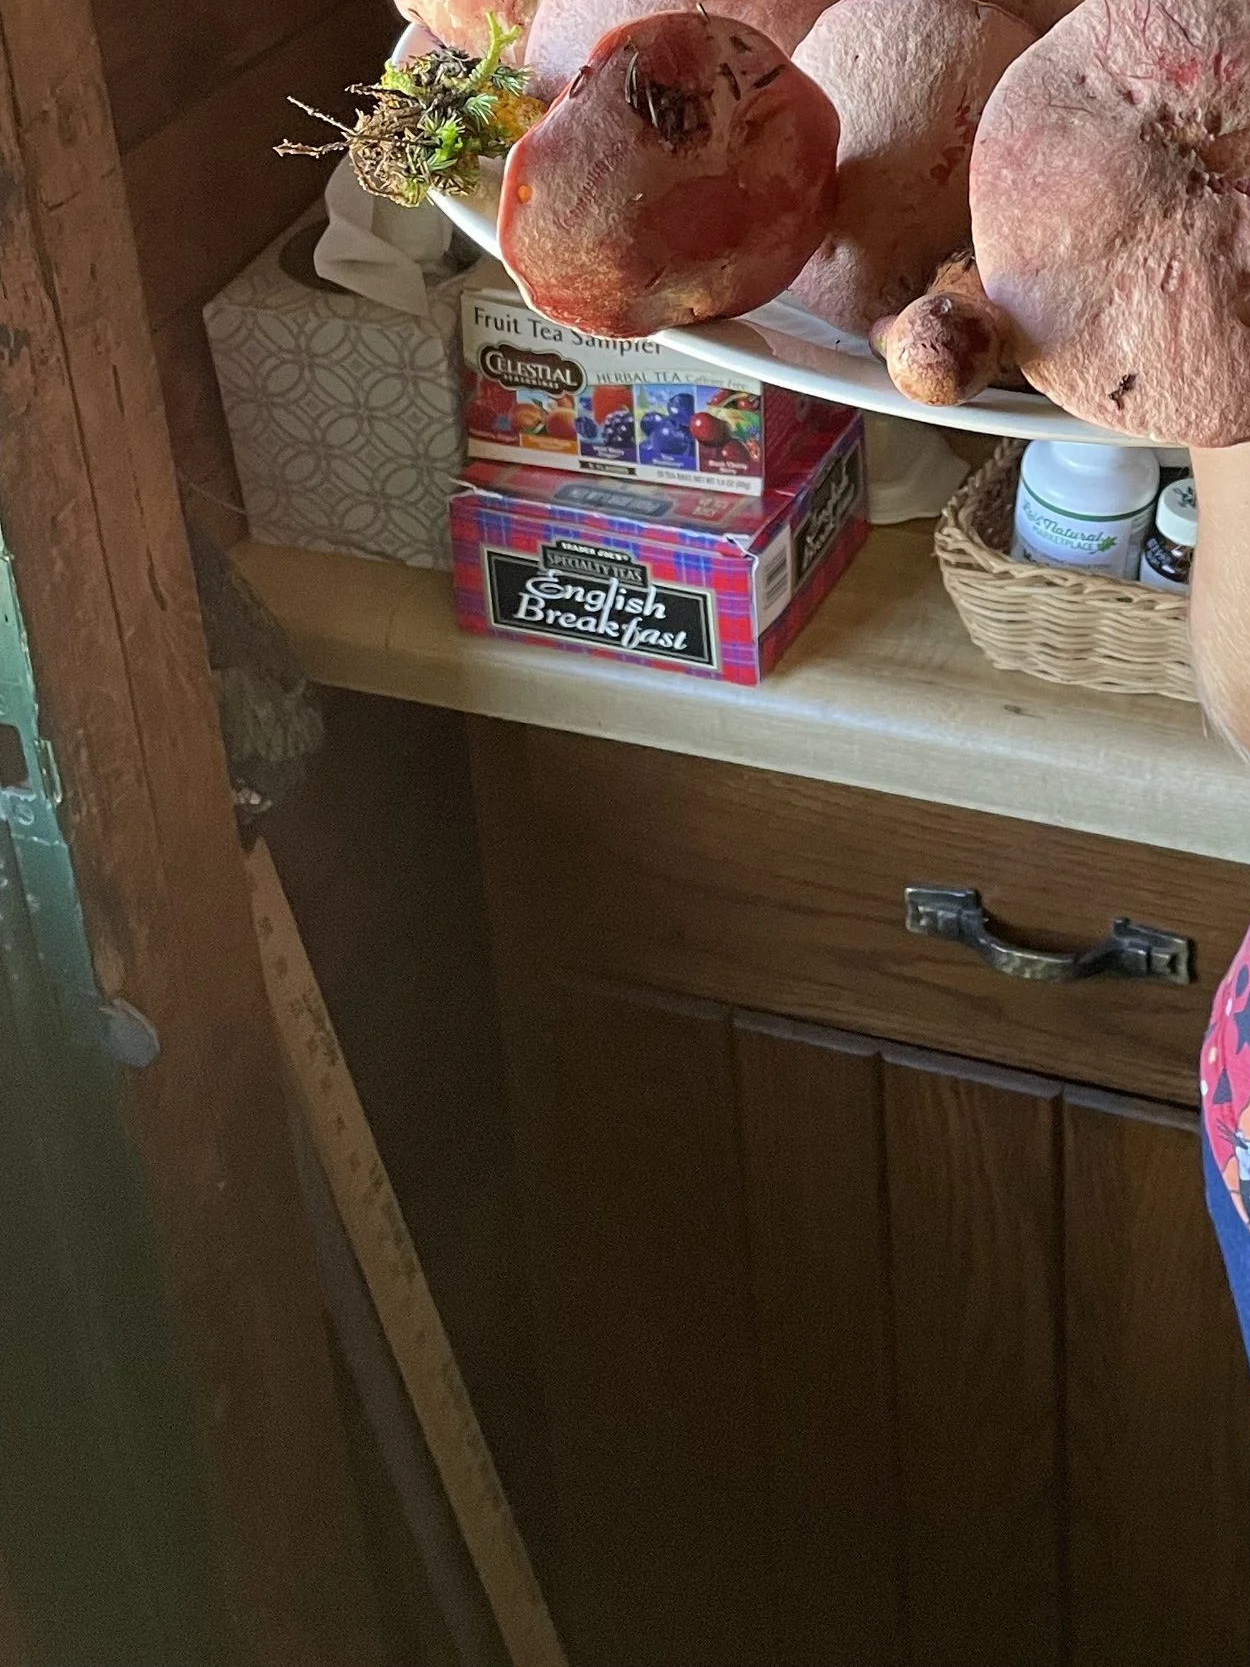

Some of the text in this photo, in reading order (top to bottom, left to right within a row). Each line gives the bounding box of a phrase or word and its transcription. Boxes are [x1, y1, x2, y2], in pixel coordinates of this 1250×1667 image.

[474, 306, 521, 335] Fruit
[528, 318, 563, 342] Tea
[485, 350, 578, 387] CELESTIAL
[596, 371, 650, 384] HERBAL
[655, 373, 681, 384] TEA
[1043, 518, 1104, 542] Natural
[560, 541, 626, 561] TRADER JOE'S
[548, 553, 643, 582] SPECIALTY TEAS
[525, 568, 666, 620] English
[512, 590, 688, 650] Breakfast
